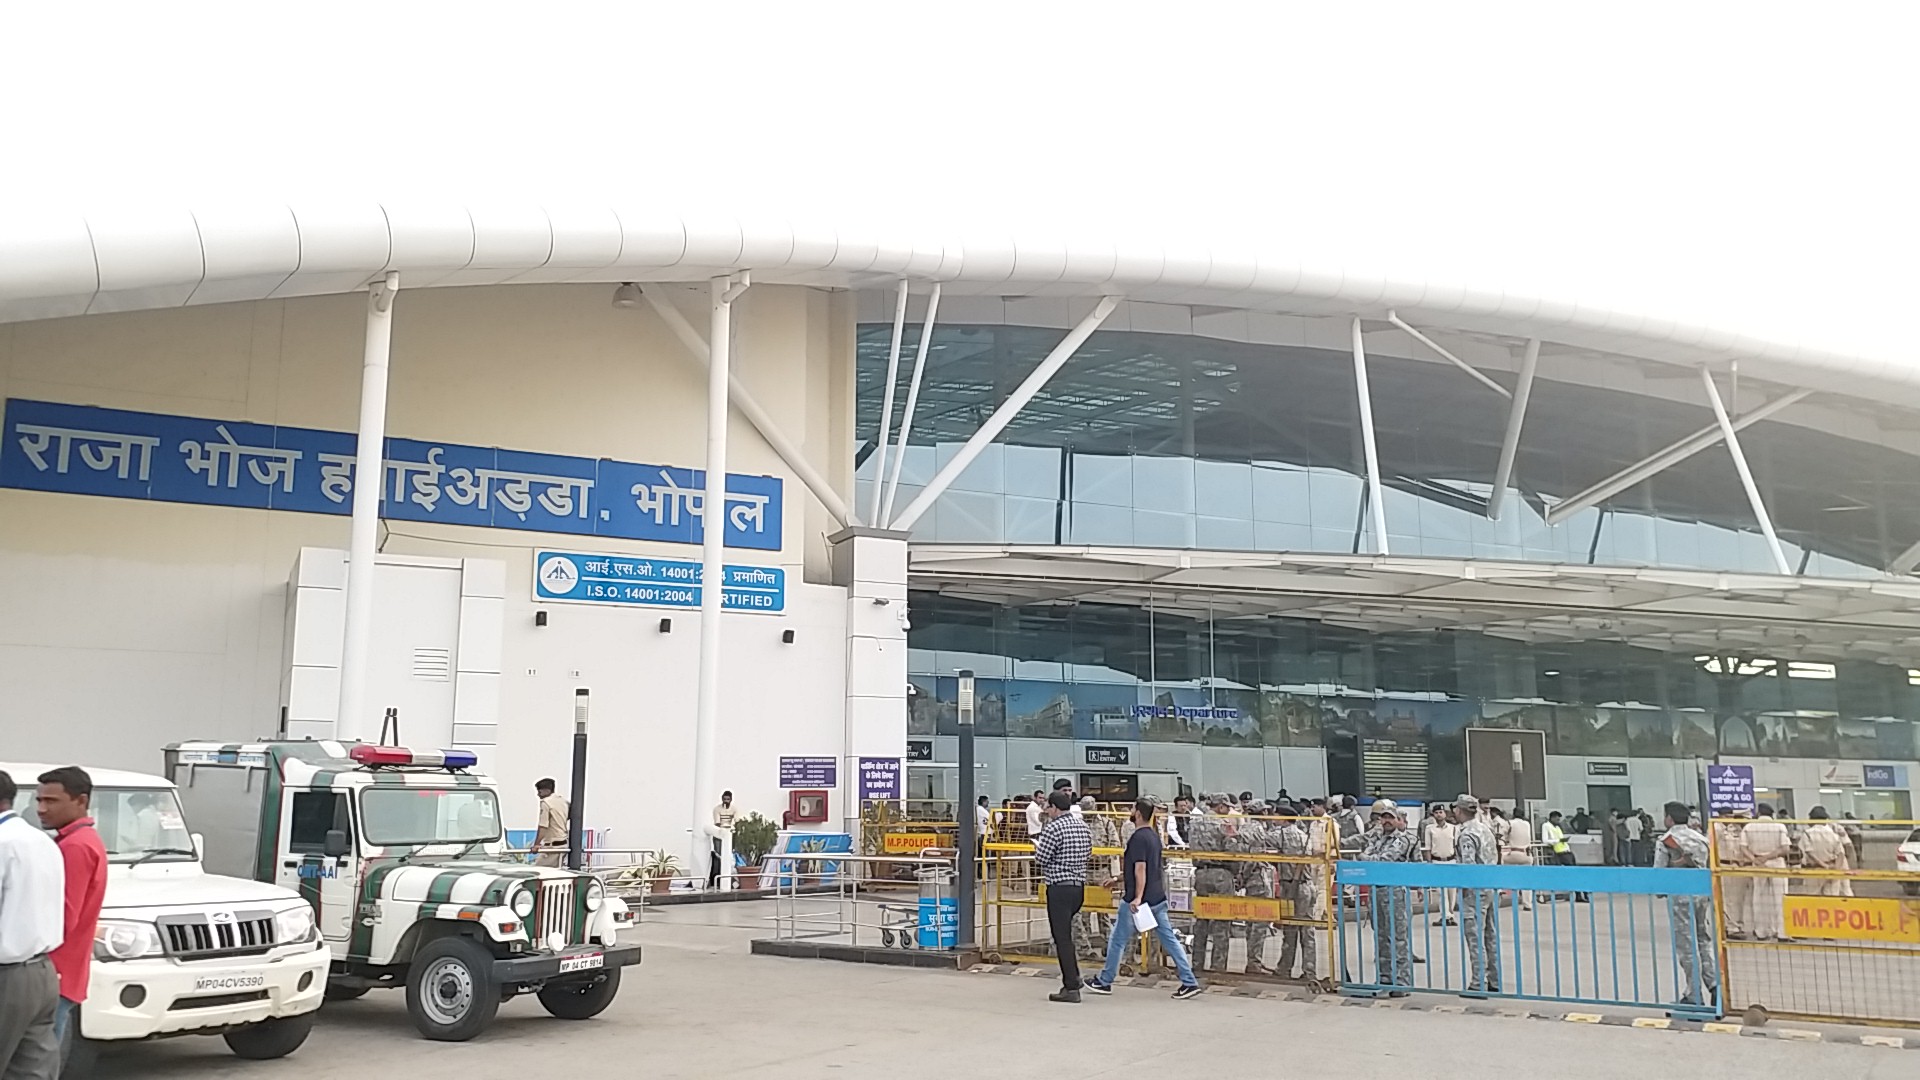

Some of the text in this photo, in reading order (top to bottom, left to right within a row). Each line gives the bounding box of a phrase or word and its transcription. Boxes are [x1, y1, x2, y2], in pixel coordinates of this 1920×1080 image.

[15, 423, 160, 481] राजा
[179, 425, 302, 493] भोज
[631, 469, 770, 533] भोपल
[661, 566, 726, 581] 14001:24
[733, 569, 776, 584] प्रमाणित
[587, 585, 773, 607] I.S.O. 14001:2004 RTIFIED
[1175, 705, 1238, 720] Departure
[1712, 793, 1733, 801] DROP
[1740, 793, 1752, 801] GO
[887, 838, 934, 848] M.P.POLICE
[581, 960, 588, 968] CT
[196, 976, 264, 989] MP04CV5390
